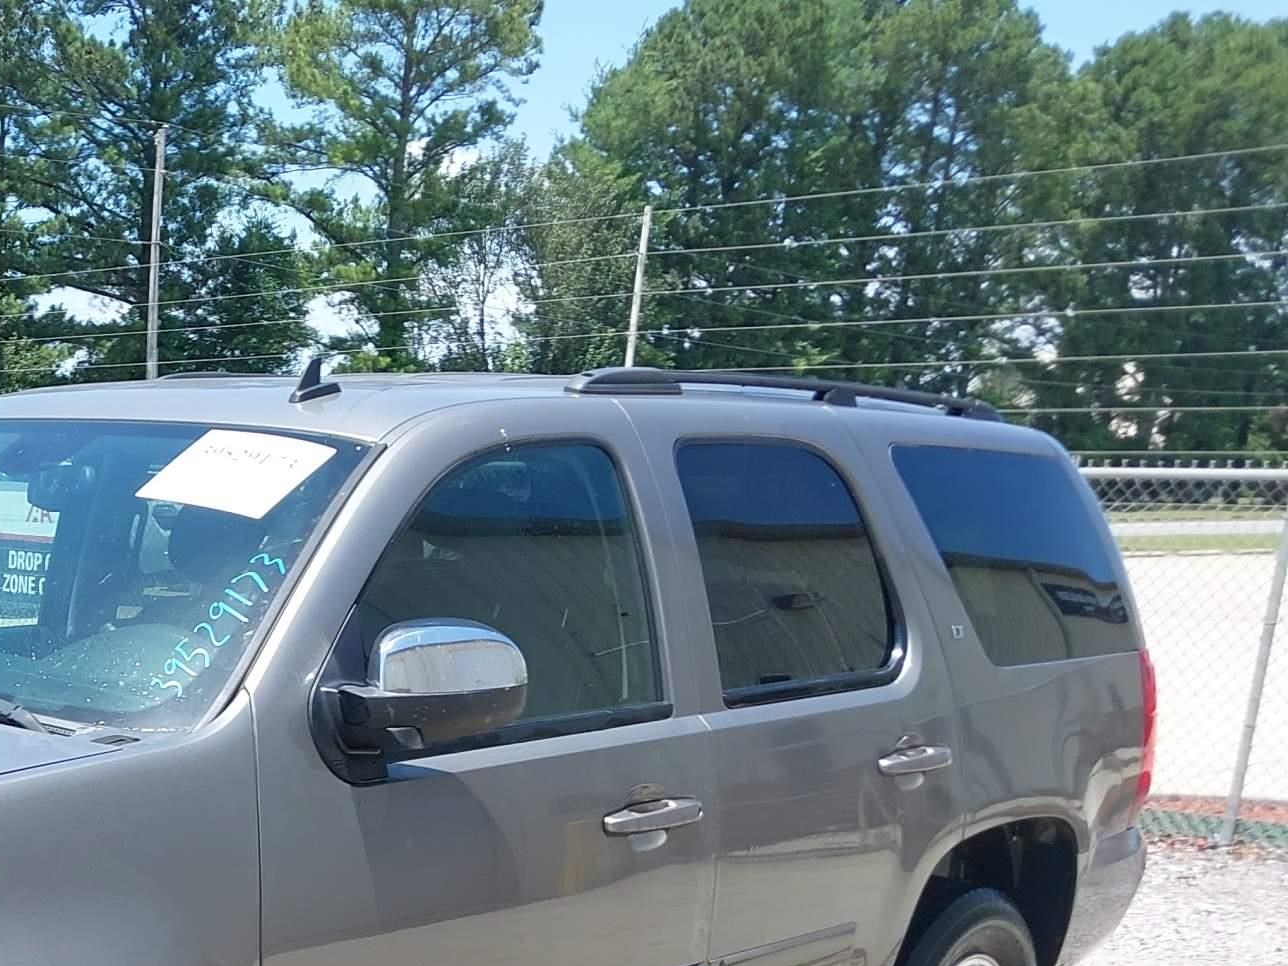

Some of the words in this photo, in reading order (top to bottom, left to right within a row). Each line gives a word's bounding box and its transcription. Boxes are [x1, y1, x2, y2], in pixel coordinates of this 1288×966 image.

[8, 549, 43, 571] DROP
[2, 573, 37, 595] ZONE
[150, 553, 286, 698] 39529173
